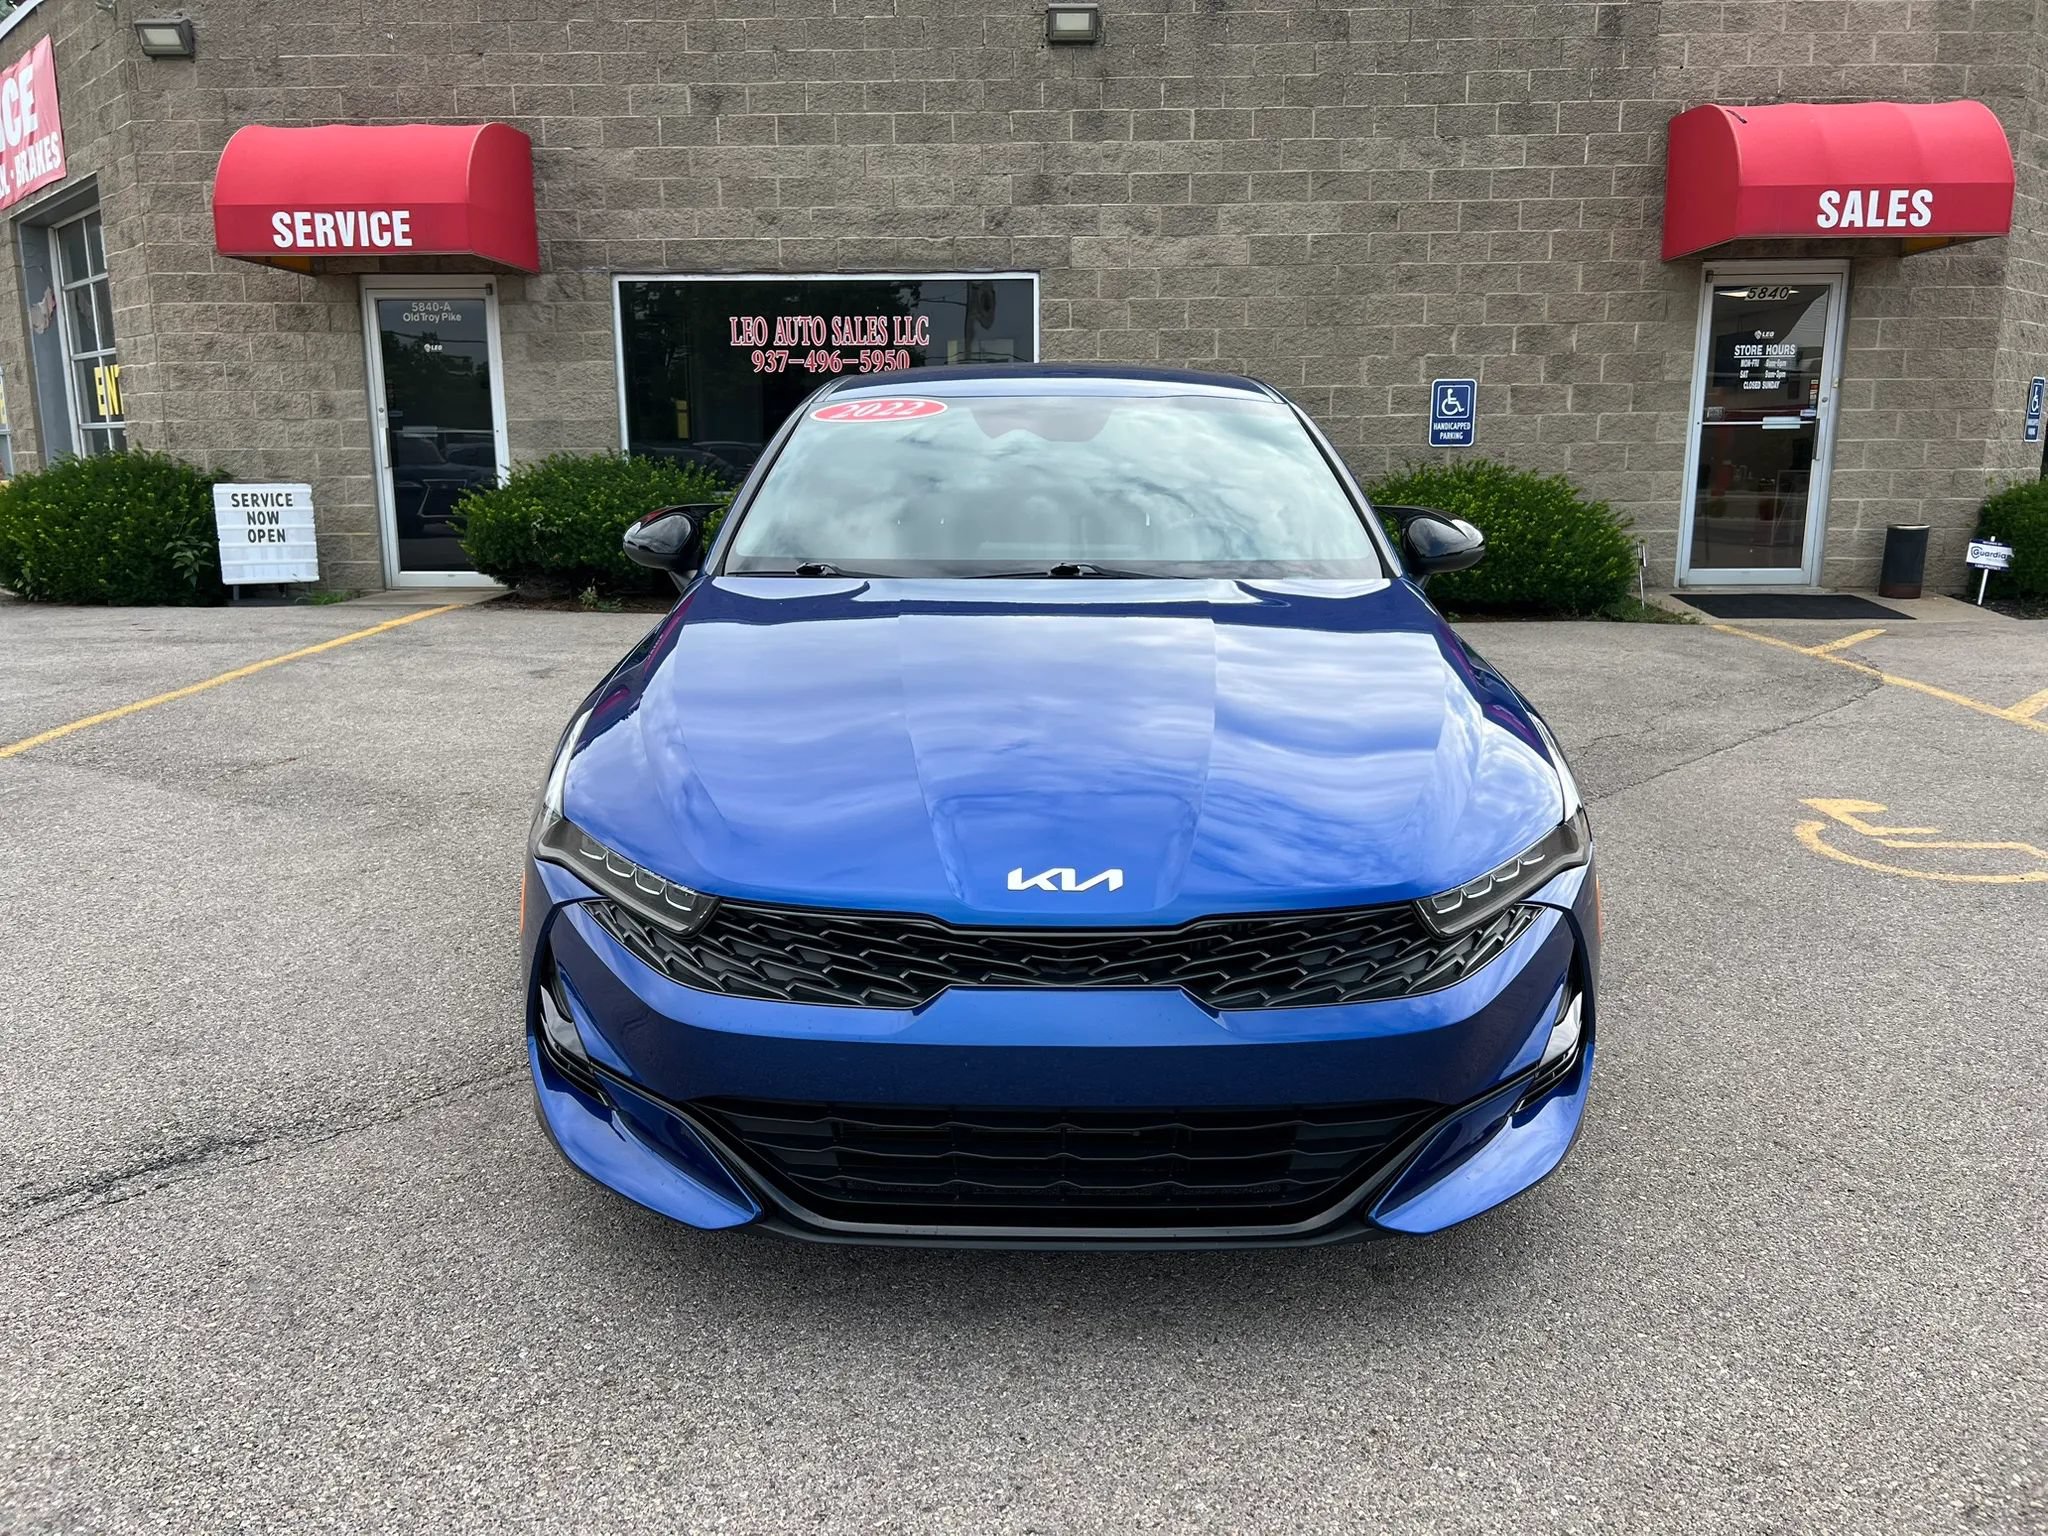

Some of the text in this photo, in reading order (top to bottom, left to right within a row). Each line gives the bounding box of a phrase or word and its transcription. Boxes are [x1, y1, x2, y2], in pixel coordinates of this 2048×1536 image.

[14, 131, 62, 187] BRAKES
[1817, 189, 1933, 228] SALES
[271, 210, 413, 248] SERVICE
[1746, 286, 1789, 299] 5840
[412, 302, 451, 311] 5840-A
[403, 313, 462, 323] Old Troy Pike
[729, 315, 930, 346] LEO AUTO SALES LLC
[1734, 343, 1796, 356] STORE HOURS
[751, 349, 911, 373] 937-496-5950
[1739, 370, 1749, 378] SAT
[1743, 381, 1780, 389] CLOSED SUNDAY
[829, 402, 925, 418] 2022
[1433, 422, 1471, 430] HANDICAPPED
[1440, 431, 1464, 440] PARKING
[231, 493, 293, 507] SERVICE
[246, 510, 280, 525] NOW
[247, 528, 286, 543] OPEN
[1007, 867, 1124, 892] KIA
